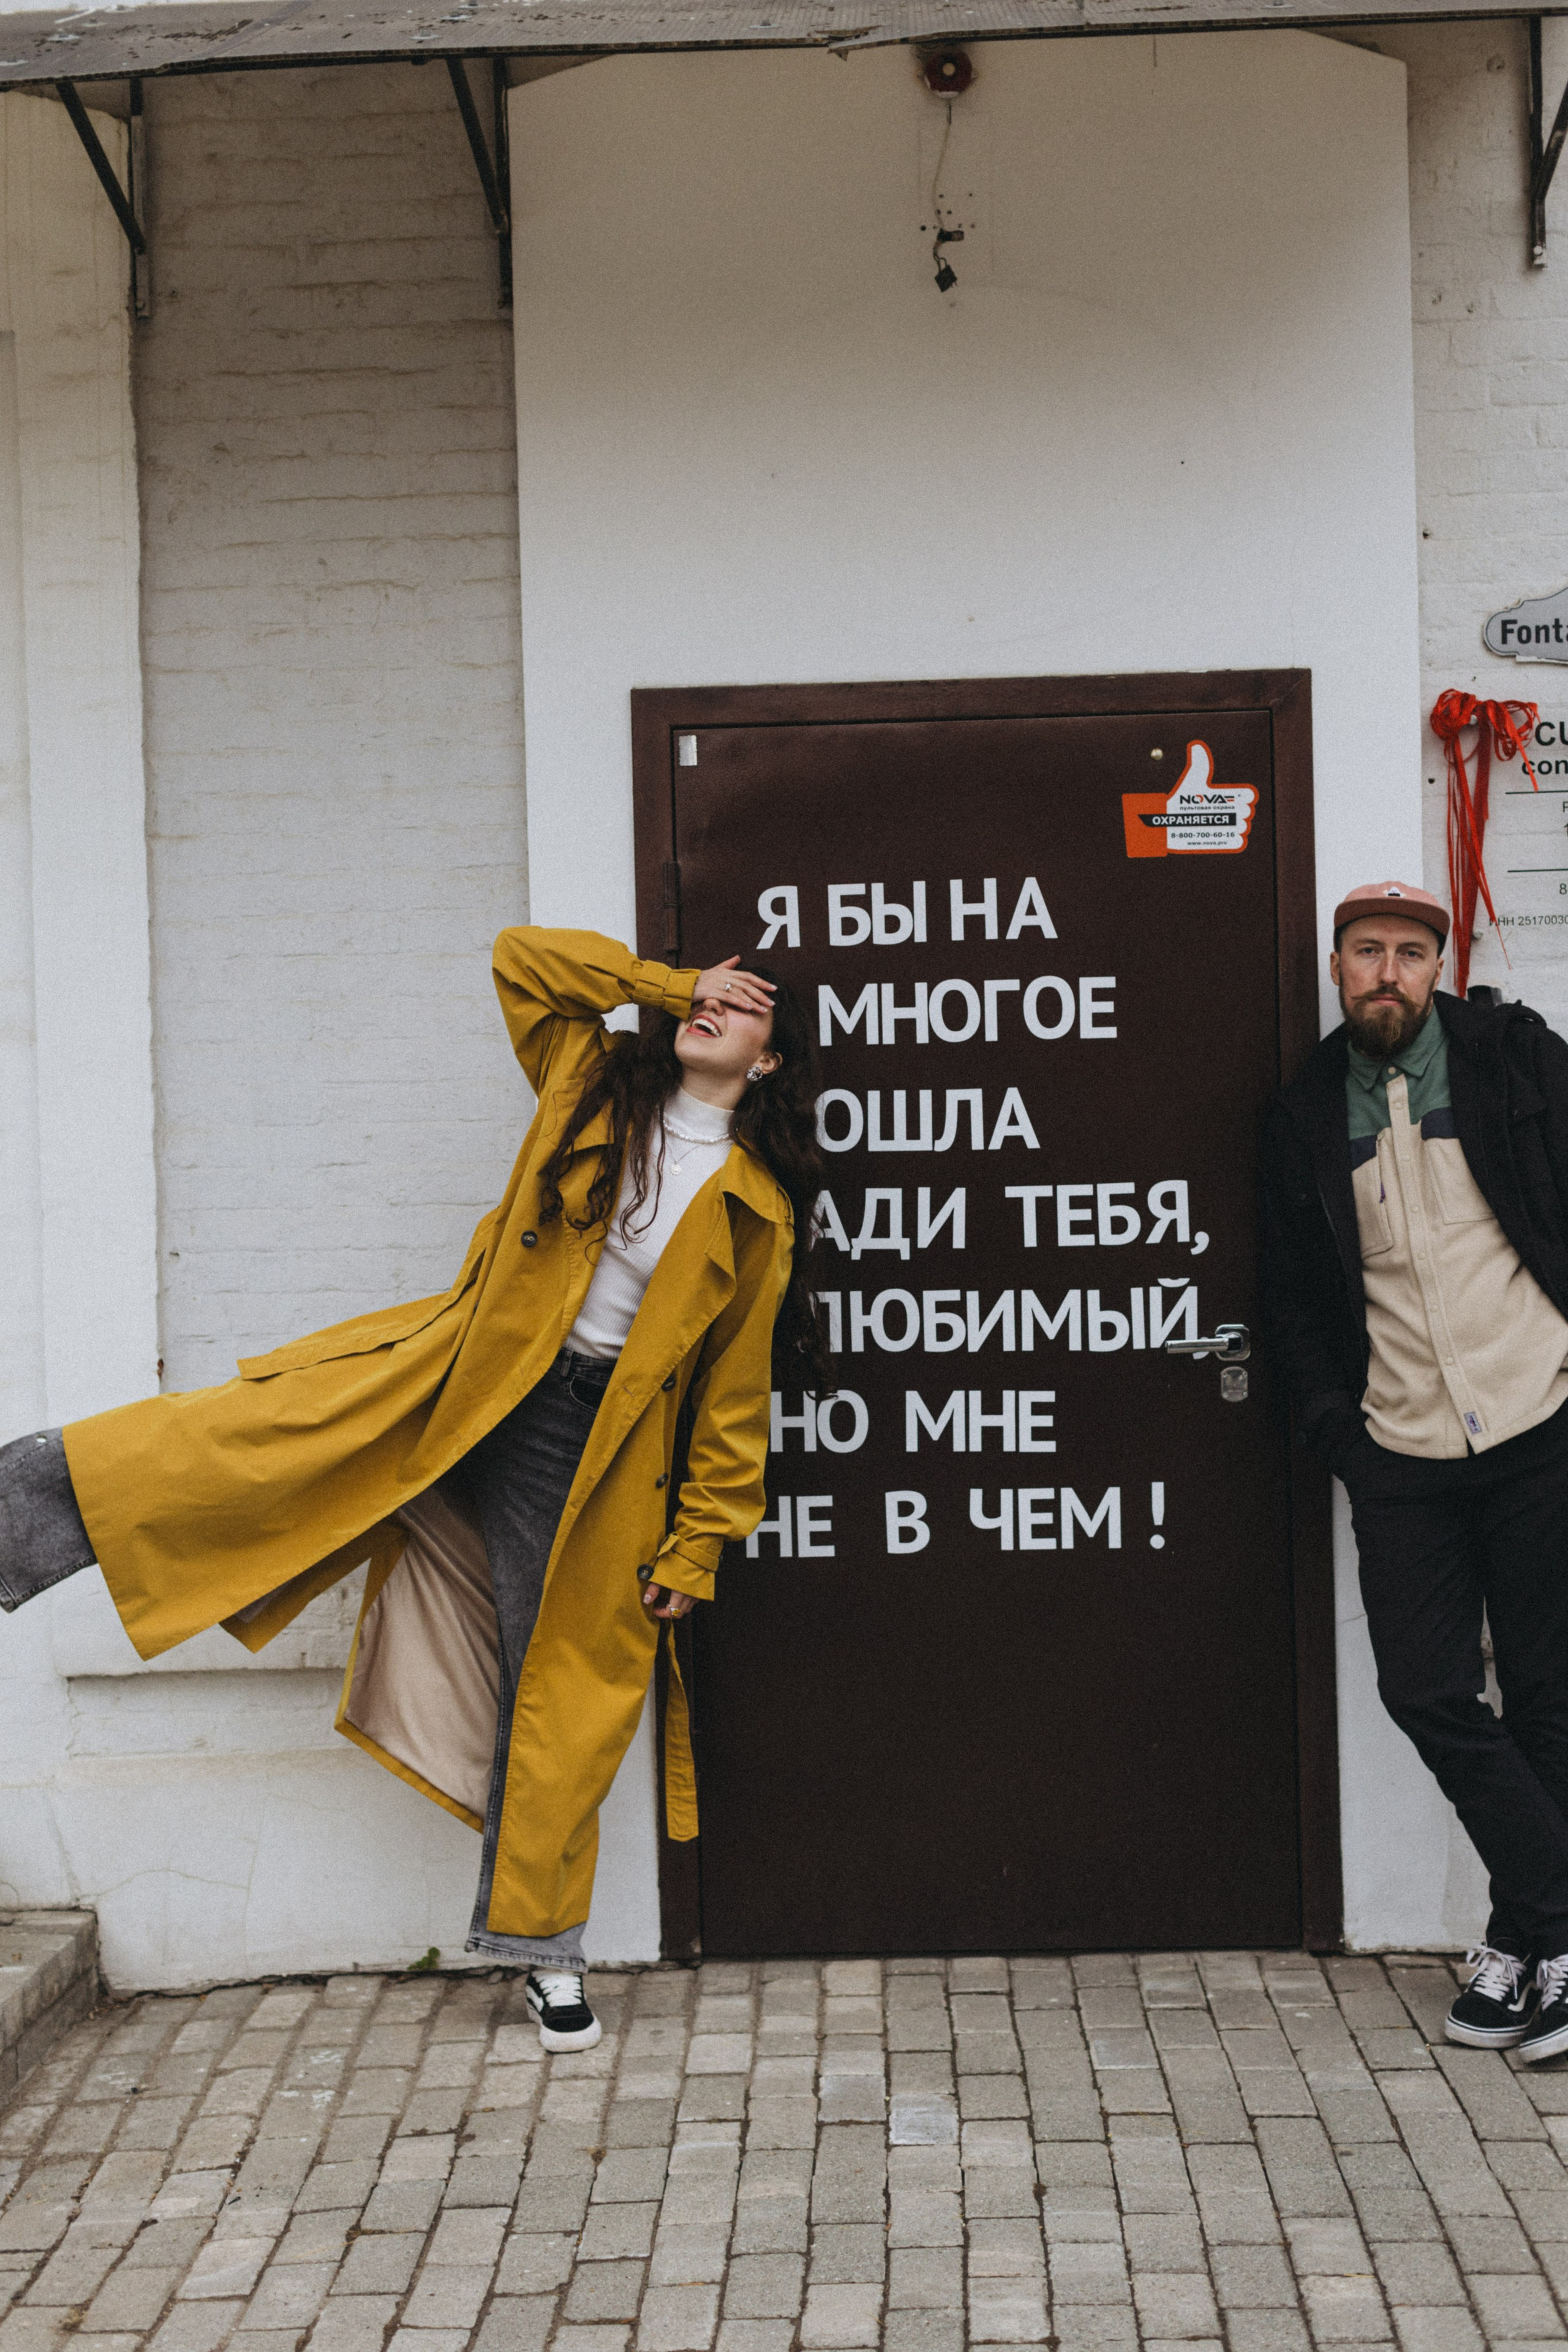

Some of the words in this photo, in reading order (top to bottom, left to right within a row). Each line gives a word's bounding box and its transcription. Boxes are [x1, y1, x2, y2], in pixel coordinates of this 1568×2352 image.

[1501, 618, 1568, 644] Font
[1152, 815, 1229, 825] ОХРАНЯЕТСЯ
[1180, 794, 1227, 804] NOVA
[756, 886, 801, 949] Я
[827, 880, 927, 946] БЫ
[949, 876, 1058, 941] НА
[818, 976, 1117, 1046] МНОГОЕ
[815, 1087, 1041, 1152] ОШЛА
[809, 1186, 966, 1260] АДИ
[1005, 1180, 1210, 1255] ТЕБЯ,
[770, 1390, 869, 1453] НО
[905, 1390, 1057, 1452] МНЕ
[746, 1495, 835, 1558] НЕ
[885, 1490, 930, 1554] В
[969, 1487, 1121, 1551] ЧЕМ
